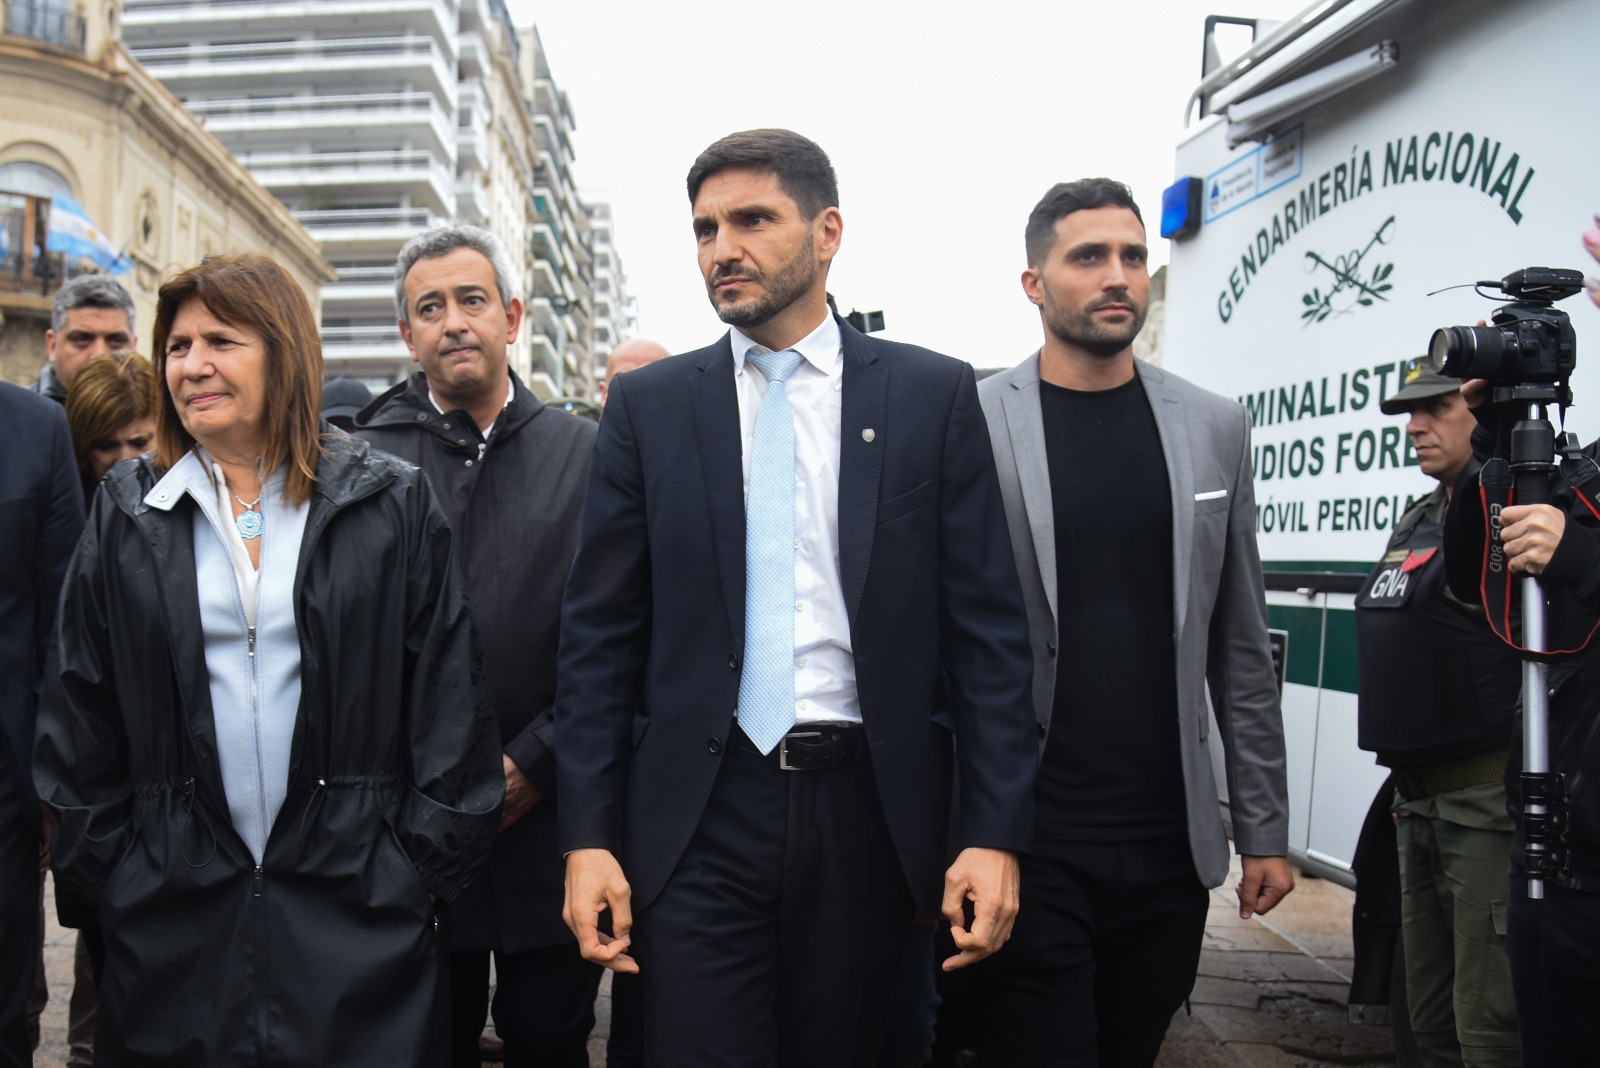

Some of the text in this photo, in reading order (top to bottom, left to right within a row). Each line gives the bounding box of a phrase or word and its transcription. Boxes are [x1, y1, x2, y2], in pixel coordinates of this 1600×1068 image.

[1218, 131, 1535, 324] GENDARMERÍA NACIONAL
[1370, 568, 1409, 599] GNA
